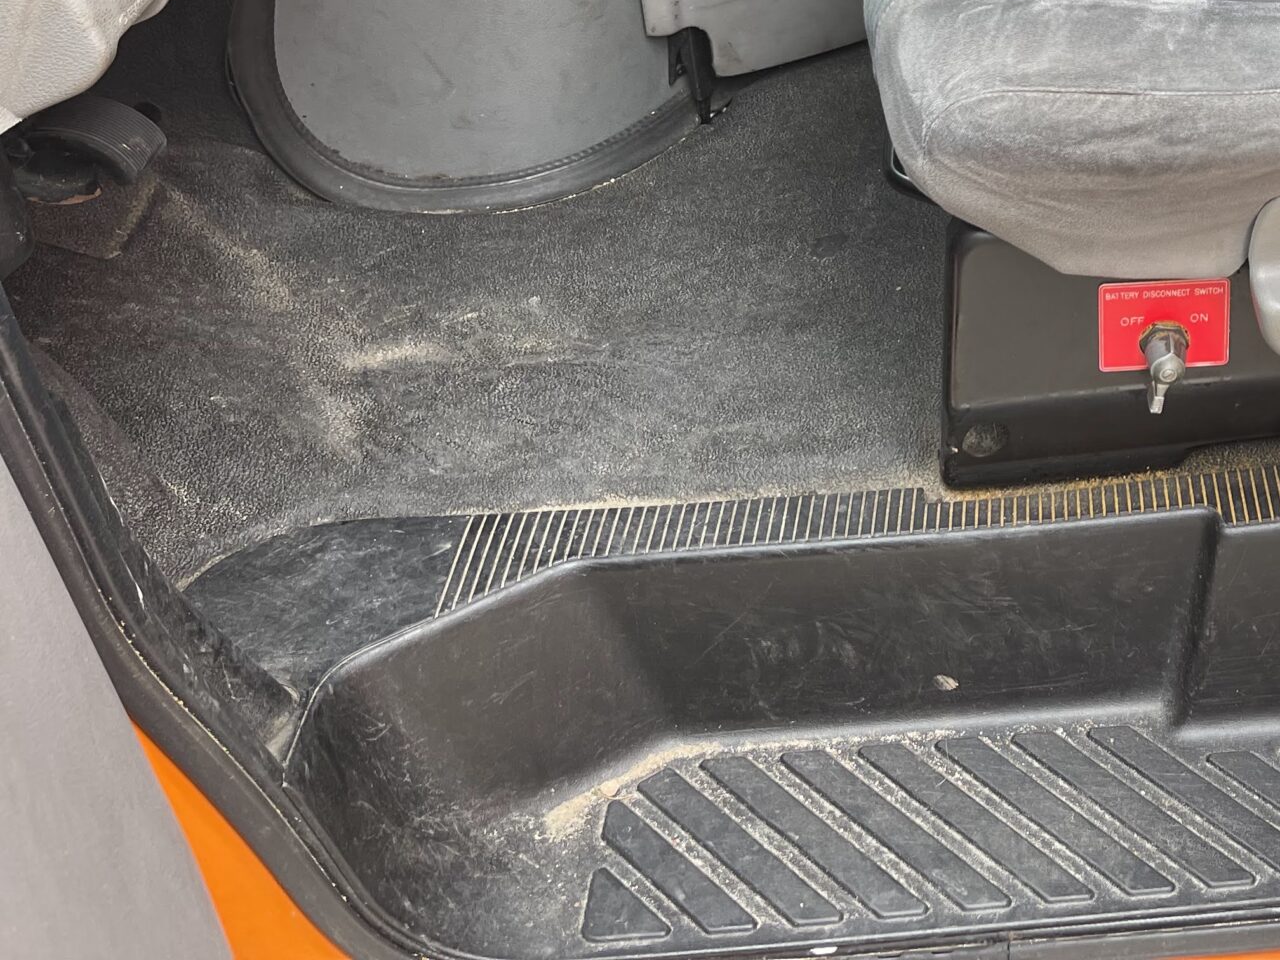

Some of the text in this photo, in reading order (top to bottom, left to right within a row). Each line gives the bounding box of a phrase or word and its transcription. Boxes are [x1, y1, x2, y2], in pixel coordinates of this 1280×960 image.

[1105, 287, 1224, 300] BATTERY DISCONNECT SWITCH
[1120, 316, 1144, 326] OFF
[1190, 313, 1209, 323] ON
